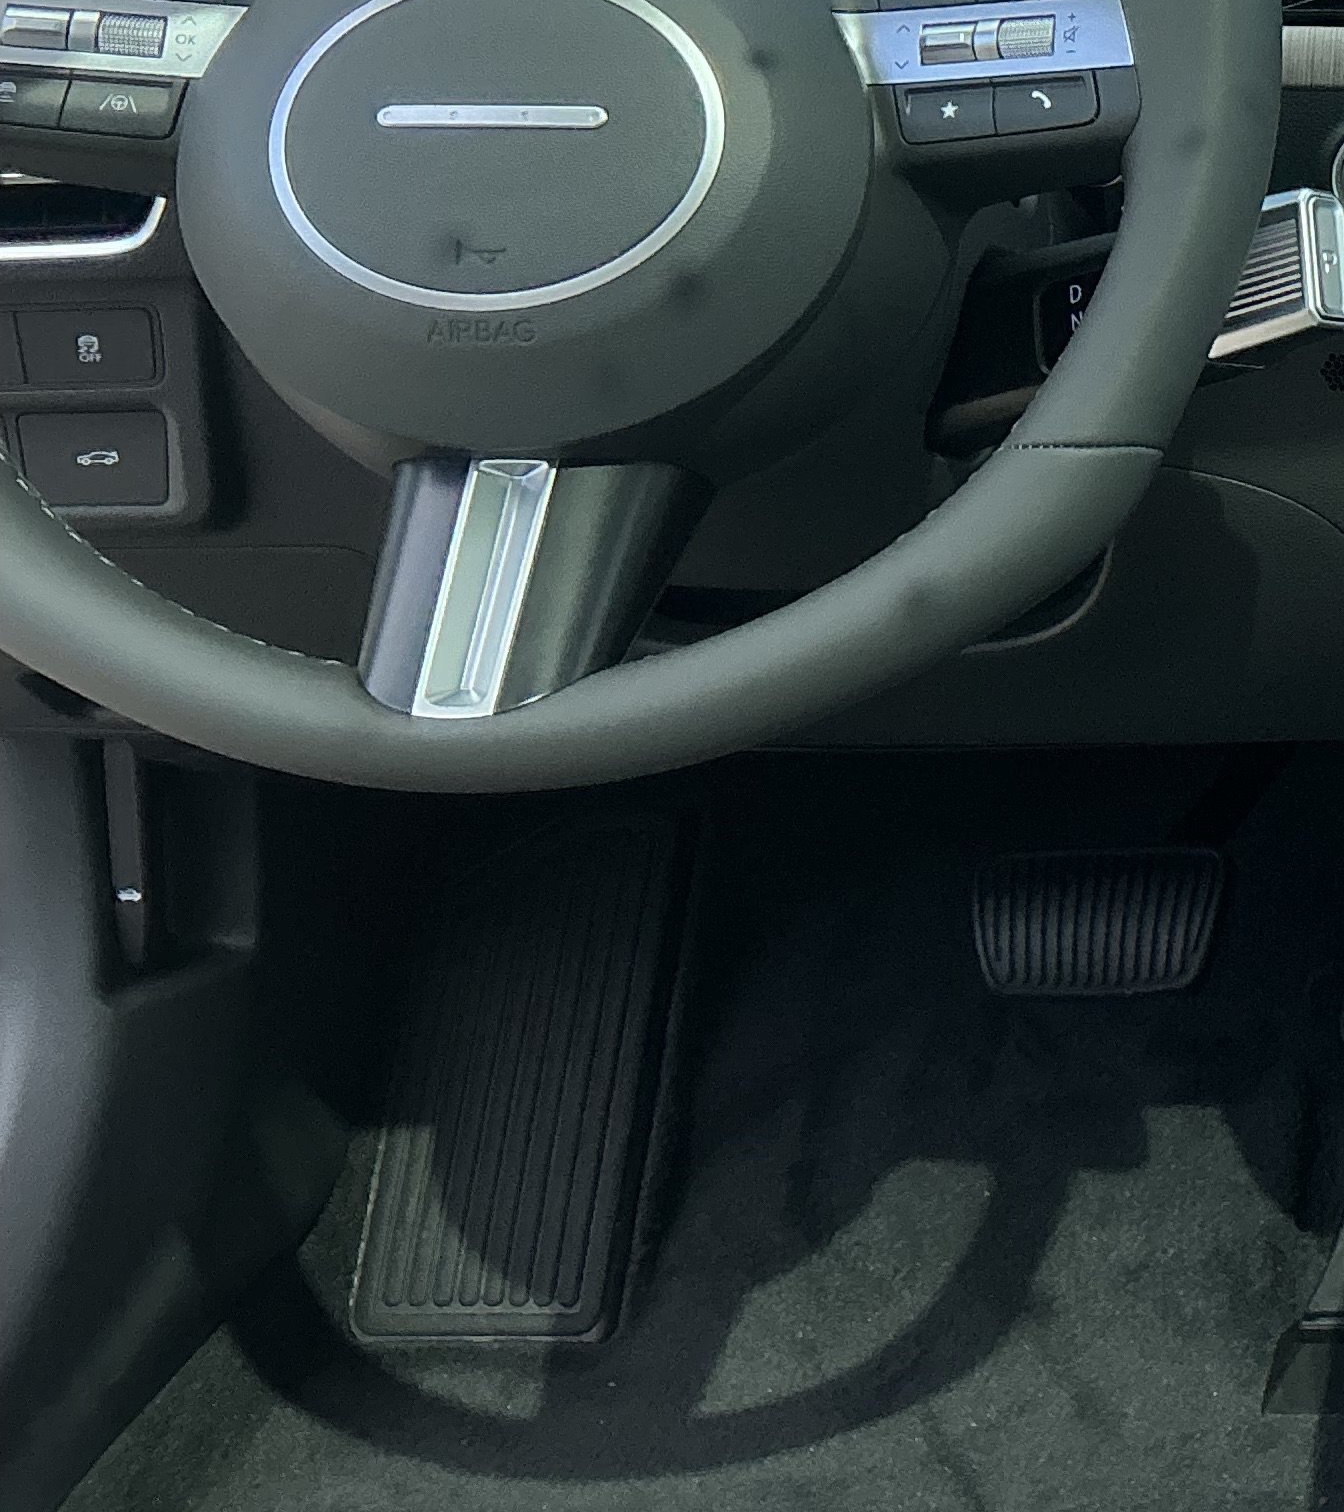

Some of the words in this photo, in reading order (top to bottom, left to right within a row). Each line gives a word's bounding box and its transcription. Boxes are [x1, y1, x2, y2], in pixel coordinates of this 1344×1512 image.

[175, 34, 196, 46] OK
[1069, 284, 1083, 305] D
[426, 319, 538, 344] AIRBAG
[78, 353, 102, 363] OFF
